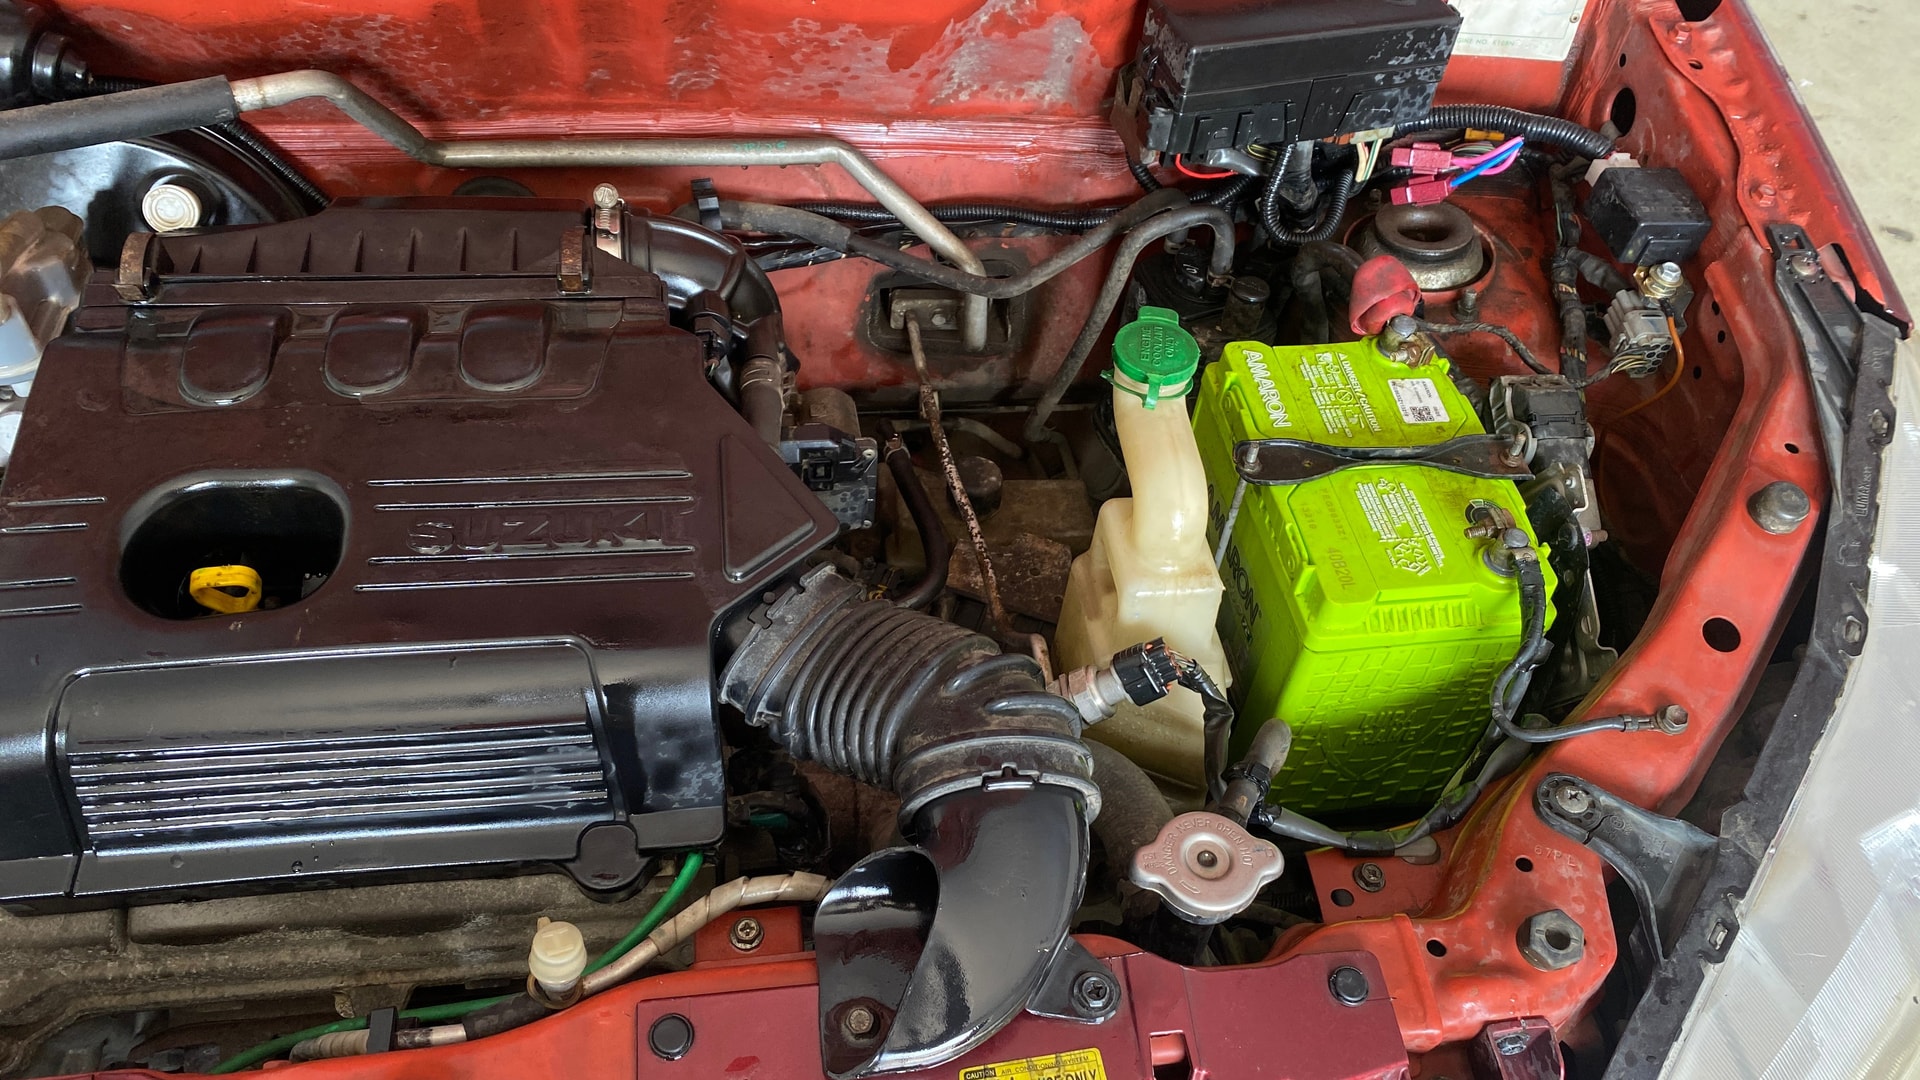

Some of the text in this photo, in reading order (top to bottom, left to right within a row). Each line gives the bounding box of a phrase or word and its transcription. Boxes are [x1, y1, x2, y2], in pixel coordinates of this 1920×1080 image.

[1140, 327, 1152, 361] ENGINE
[1152, 326, 1163, 367] COOLANT
[1164, 336, 1175, 358] ONLY
[1242, 349, 1292, 428] AMARON
[406, 510, 663, 555] SUZUKI
[1208, 484, 1259, 626] AMRON
[1162, 818, 1254, 875] DANGER NEVER OPEN HOT
[965, 1070, 996, 1080] CAUTION
[1001, 1068, 1012, 1076] AIR
[1063, 1055, 1089, 1066] SYSTEM
